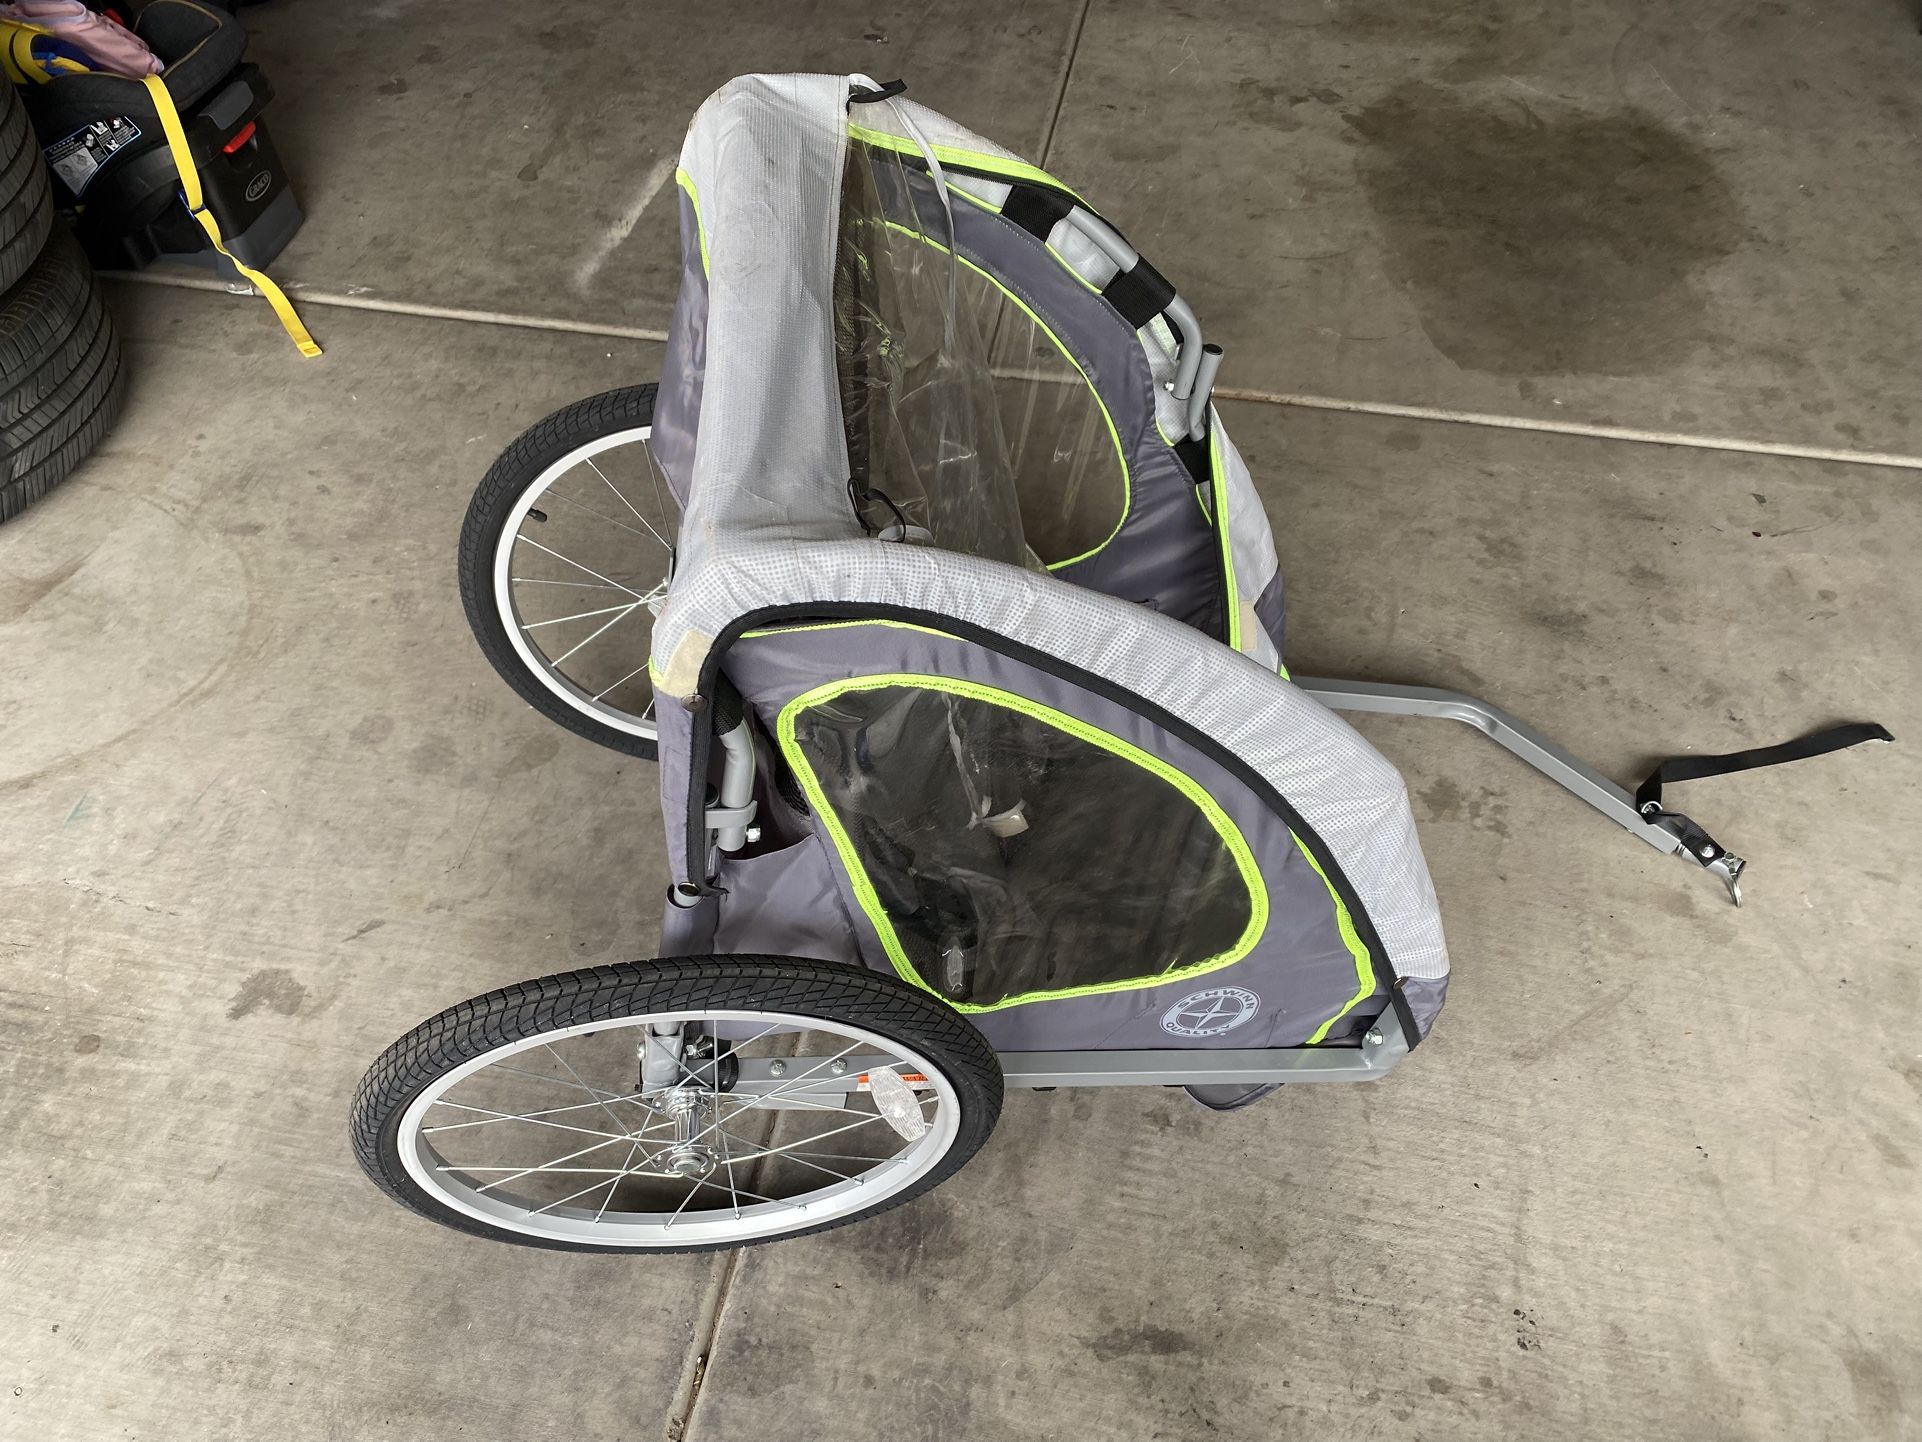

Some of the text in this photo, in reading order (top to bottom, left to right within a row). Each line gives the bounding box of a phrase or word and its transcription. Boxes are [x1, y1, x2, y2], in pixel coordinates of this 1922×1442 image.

[249, 174, 269, 197] GRACO
[1178, 989, 1256, 1010] SCHWINN
[1166, 1021, 1230, 1035] QUALITY
